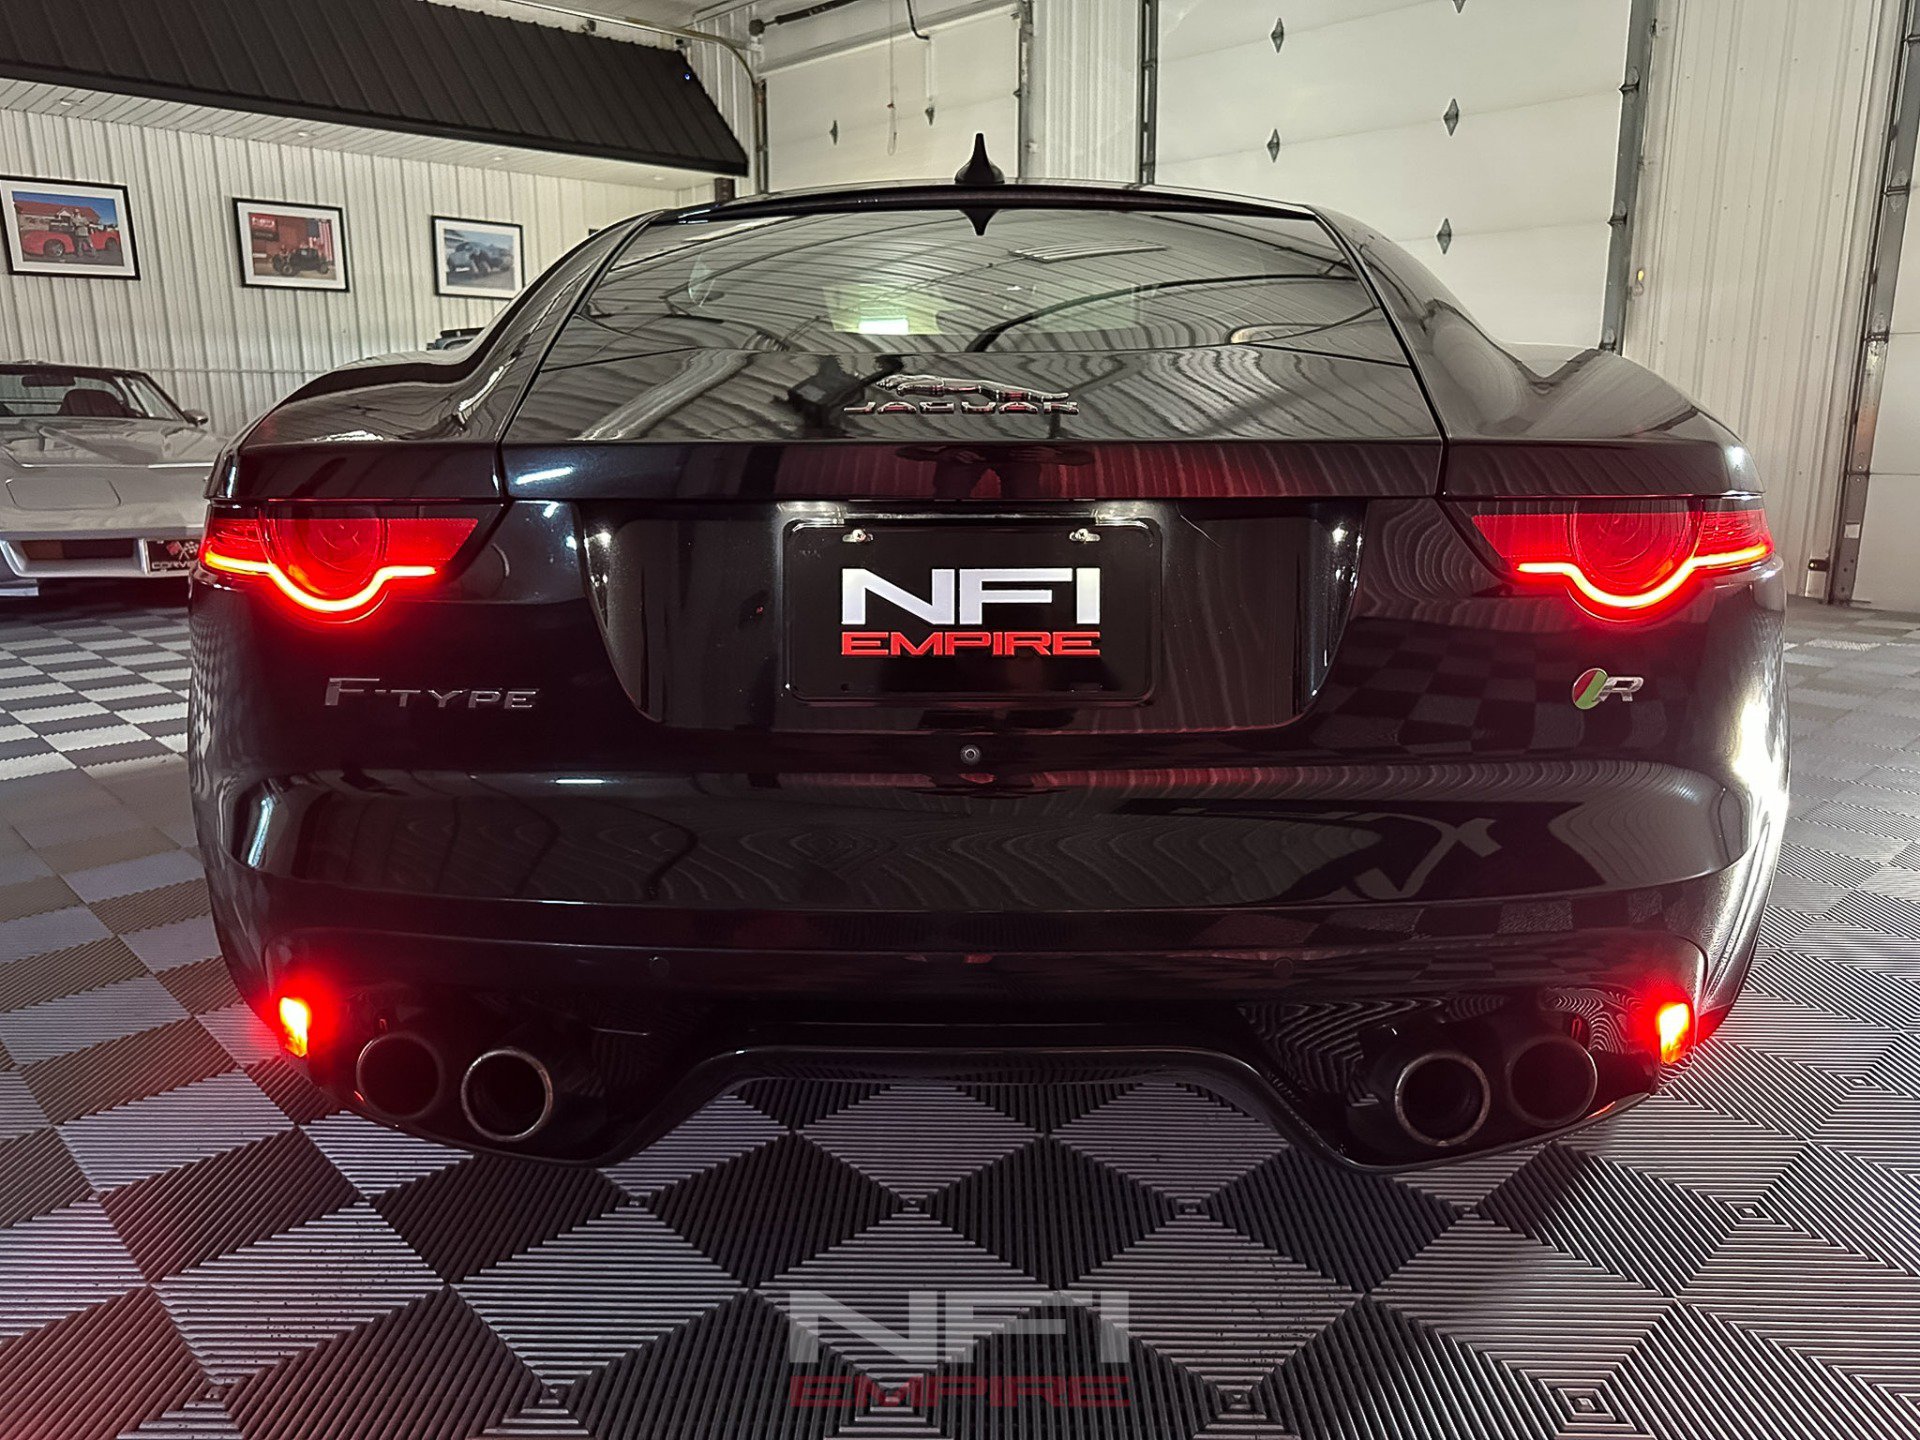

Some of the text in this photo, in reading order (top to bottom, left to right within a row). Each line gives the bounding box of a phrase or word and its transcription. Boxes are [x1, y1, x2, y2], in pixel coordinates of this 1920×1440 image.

[844, 401, 1080, 415] JAGUAR
[841, 568, 1101, 625] NFI
[841, 632, 1101, 656] EMPIRE
[324, 677, 540, 709] F-TYPE
